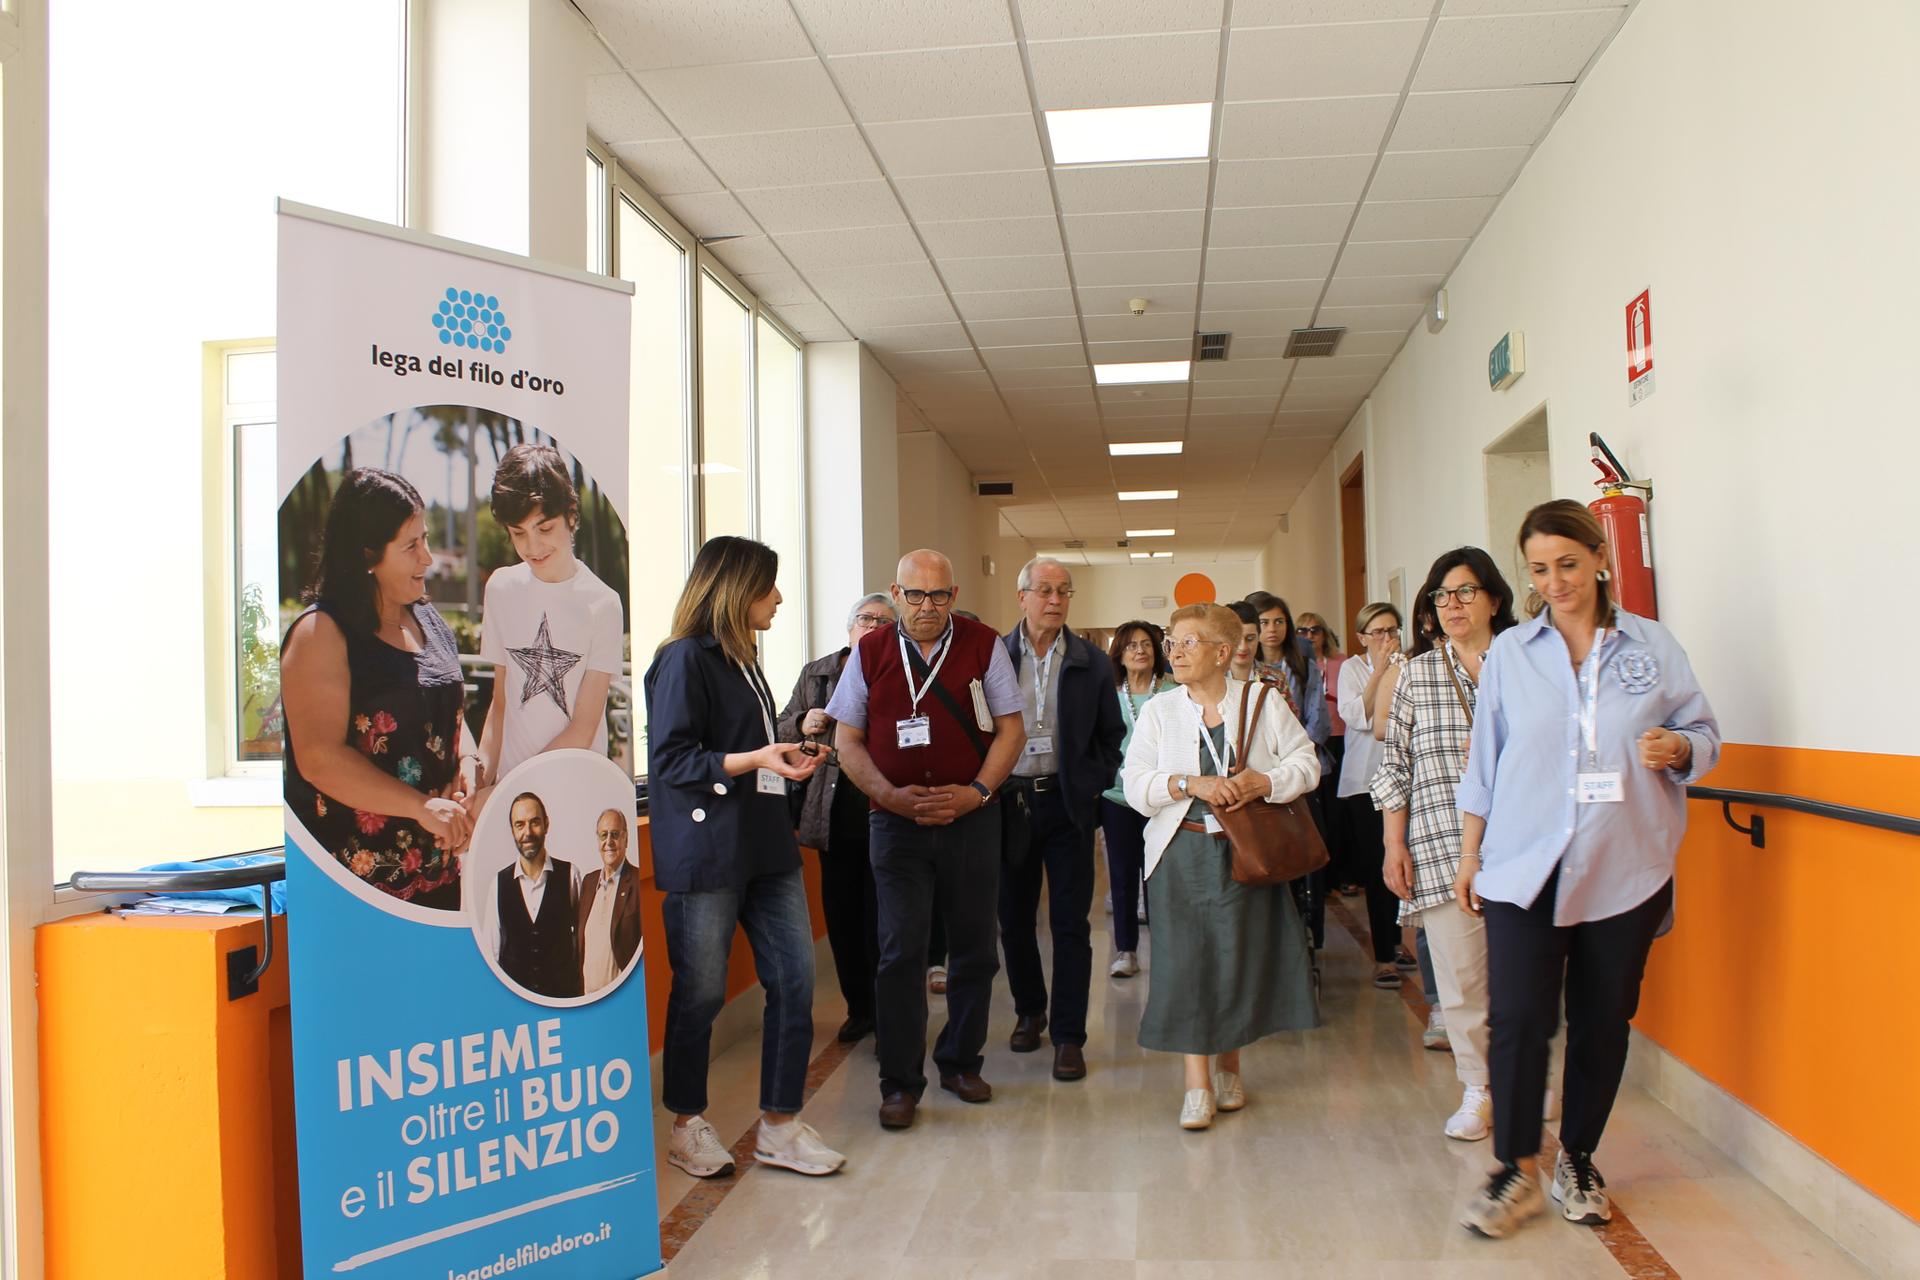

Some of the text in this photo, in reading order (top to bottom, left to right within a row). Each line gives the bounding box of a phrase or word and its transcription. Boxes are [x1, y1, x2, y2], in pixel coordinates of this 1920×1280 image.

[372, 344, 565, 396] lega del filo d'oro
[761, 774, 780, 784] STAFF
[1584, 781, 1615, 790] STAFF
[337, 1017, 563, 1112] INSIEME
[400, 1057, 633, 1146] oltre il BUIO
[340, 1109, 620, 1218] e il SILENZIO
